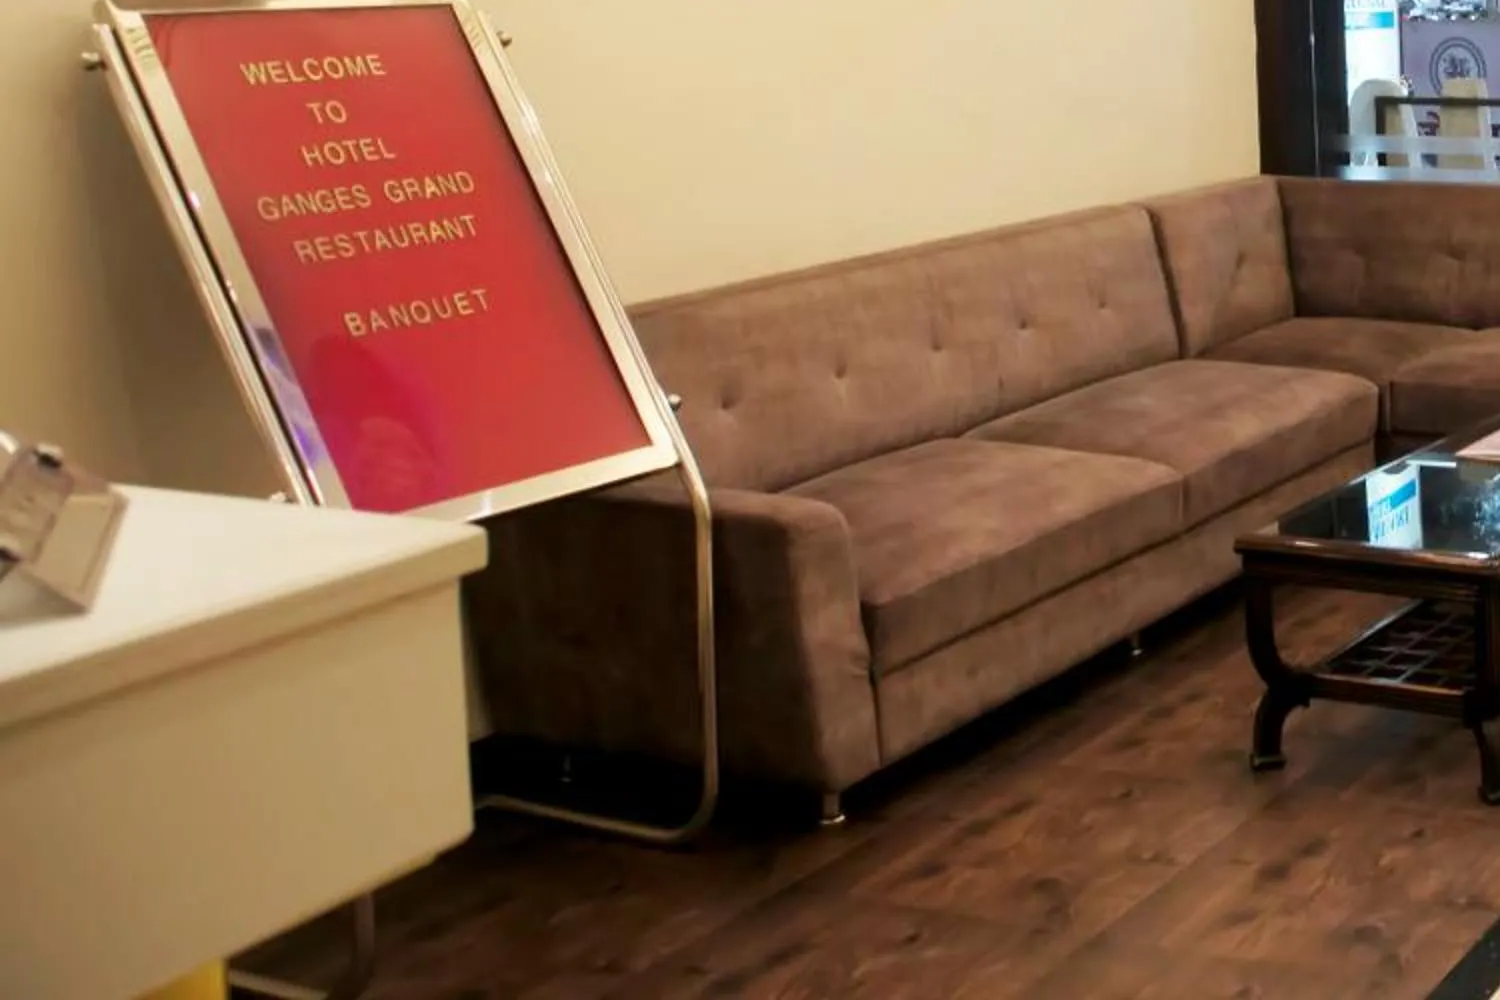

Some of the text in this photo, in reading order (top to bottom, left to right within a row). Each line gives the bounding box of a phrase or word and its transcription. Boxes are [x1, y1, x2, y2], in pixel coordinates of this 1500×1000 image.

[240, 54, 386, 87] WELCOME
[307, 101, 347, 125] TO
[301, 137, 396, 167] HOTEL
[257, 170, 476, 222] GANGES GRAND
[293, 214, 480, 265] RESTAURANT
[344, 288, 490, 338] BANQUET
